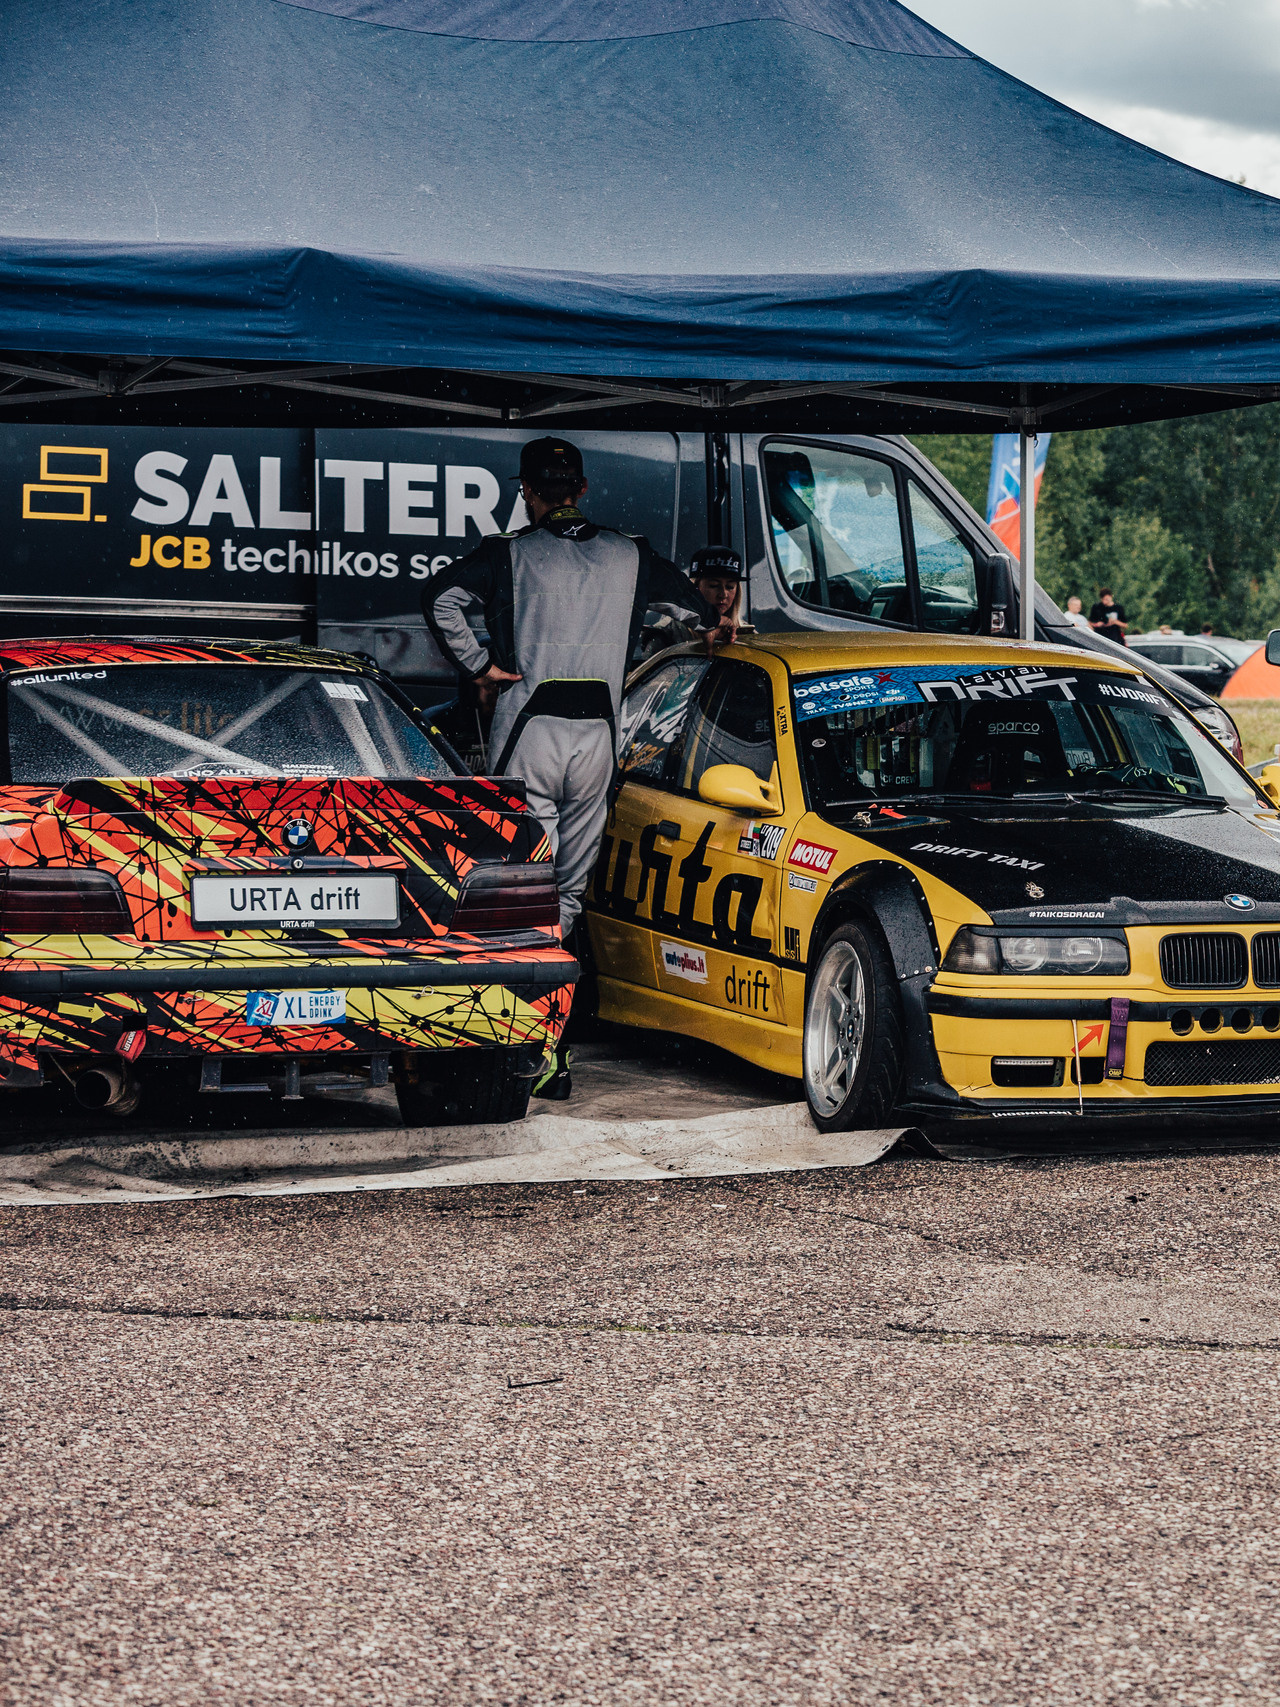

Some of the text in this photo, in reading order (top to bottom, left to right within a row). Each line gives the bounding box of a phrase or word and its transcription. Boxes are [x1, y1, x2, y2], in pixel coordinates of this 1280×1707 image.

[129, 534, 212, 570] JCB
[11, 670, 107, 687] #allunited
[794, 676, 874, 699] betsafe
[918, 672, 1078, 702] DRIFT
[853, 692, 879, 700] pepsi
[1098, 683, 1170, 709] #LVDRIFT
[987, 720, 1041, 735] sparco
[761, 826, 786, 859] 209
[790, 843, 834, 870] MOTUL
[909, 842, 1046, 871] DRIFT TAXI
[230, 886, 361, 911] URTA drift
[301, 920, 315, 928] drift
[1029, 911, 1105, 919] #TAIKOSDRAGAI
[725, 965, 771, 1012] drift
[284, 996, 307, 1019] XL
[309, 996, 340, 1007] ENERGY
[309, 1008, 333, 1019] DRINK
